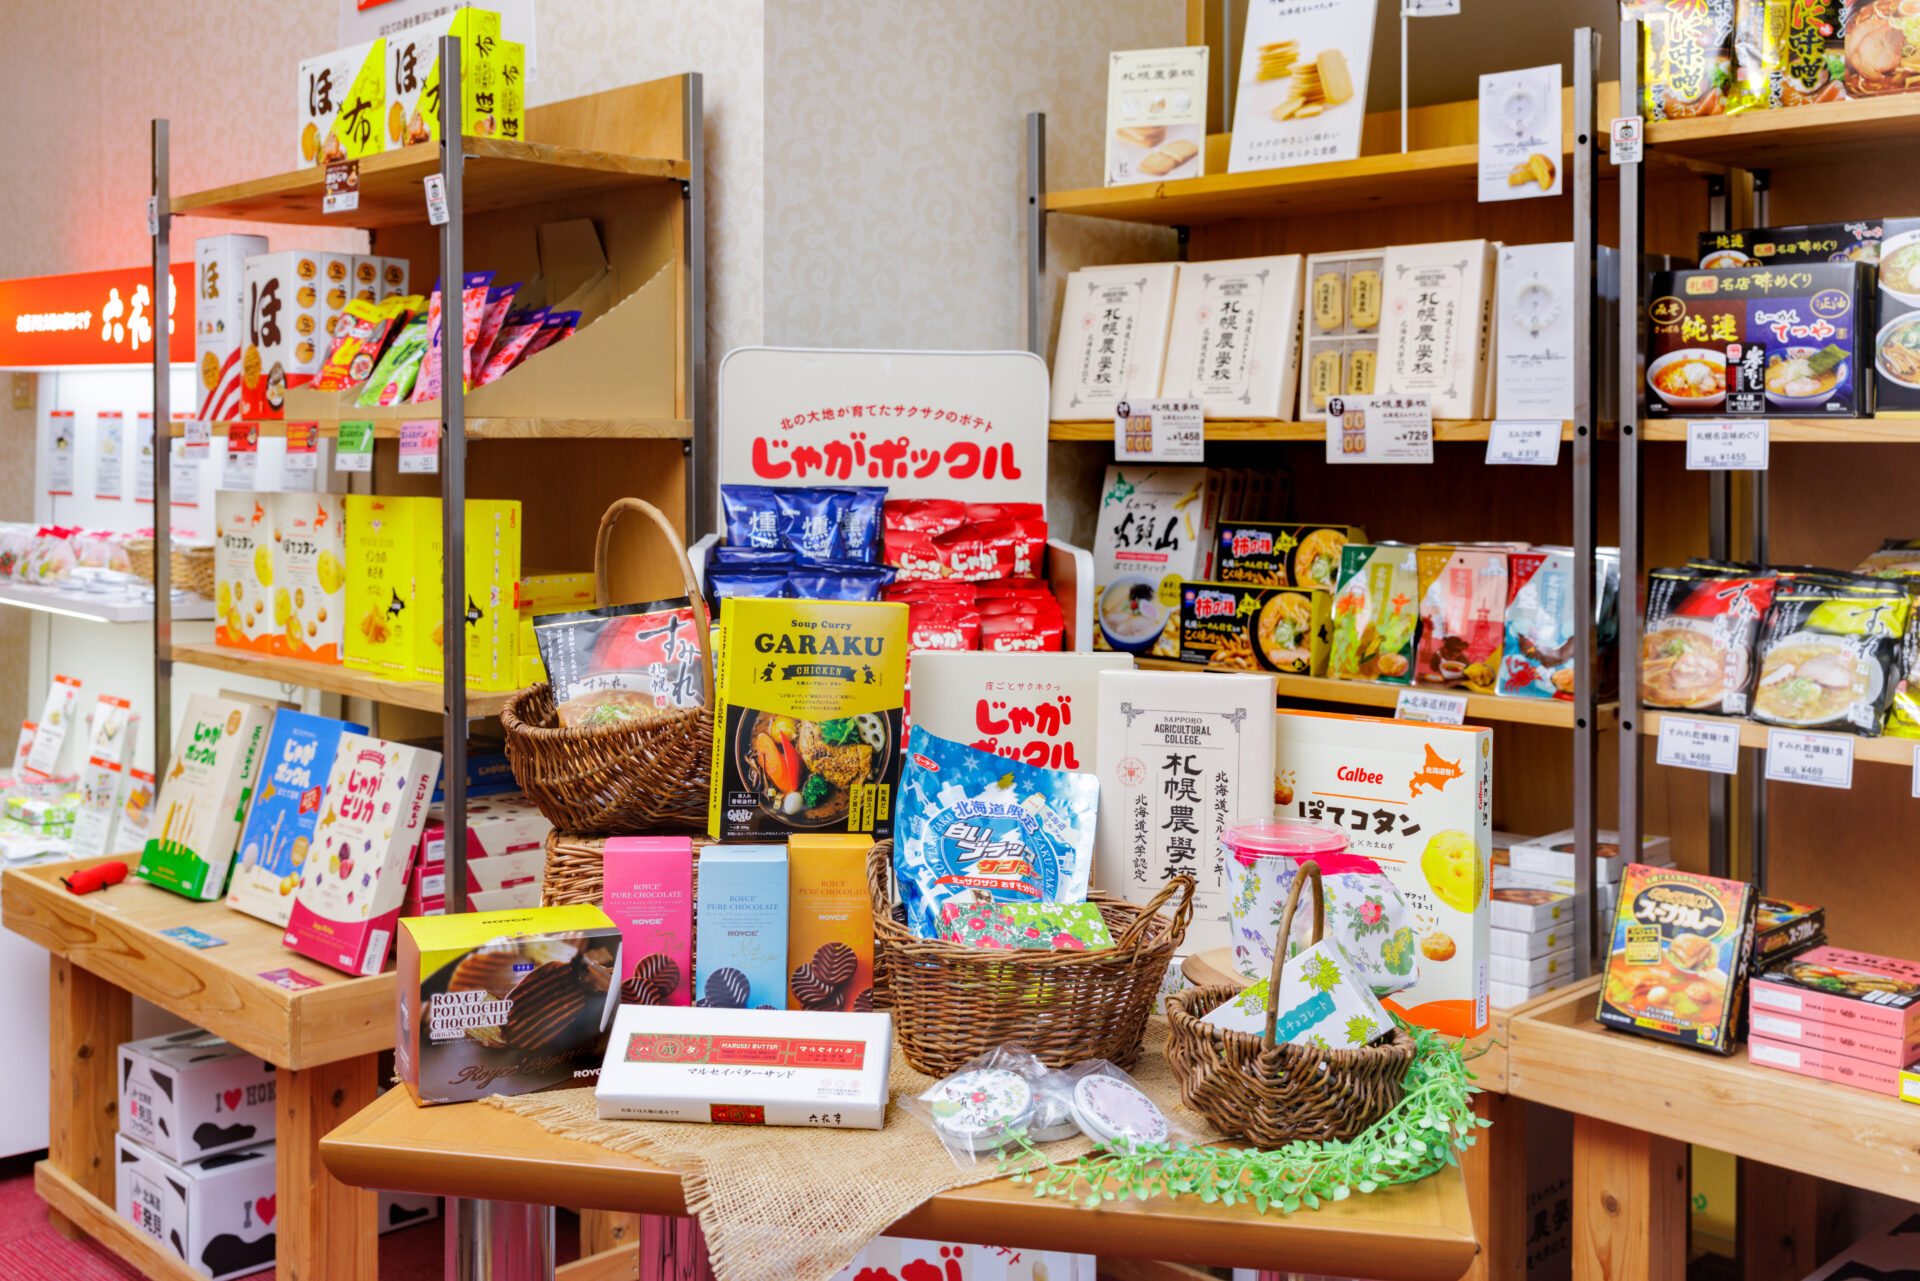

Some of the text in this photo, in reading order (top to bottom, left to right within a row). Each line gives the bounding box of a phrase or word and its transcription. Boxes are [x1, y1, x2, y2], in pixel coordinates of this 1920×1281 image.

[395, 42, 417, 95] ほ
[1789, 28, 1825, 88] 味噌
[309, 68, 333, 117] ほ
[201, 262, 219, 299] ほ
[1688, 271, 1812, 294] 札幌 名店味めぐり
[251, 278, 281, 347] ほ
[1654, 303, 1680, 316] みそ
[1410, 291, 1440, 375] 札幌農學校
[1681, 313, 1739, 343] 純連
[1771, 319, 1836, 344] てつや
[1210, 300, 1241, 382] 札幌農學校
[780, 403, 995, 434] 北の大地が育てたサクサクのポテト
[1402, 431, 1428, 441] ¥729
[1696, 431, 1760, 441] 札幌名店味めぐり
[752, 432, 1022, 481] じゃがポックル
[1232, 537, 1272, 558] 柿の種
[951, 549, 999, 571] じゃが
[1195, 598, 1235, 619] 柿の種
[791, 619, 853, 631] Soup Curry
[754, 633, 885, 657] GARAKU
[912, 629, 963, 649] じゃが
[994, 635, 1045, 651] じゃが
[636, 614, 702, 706] すみれ
[649, 663, 669, 693] 札幌
[796, 666, 843, 676] CHICKEN
[976, 695, 1072, 737] じゃが
[1163, 716, 1203, 724] SAPPORO
[1154, 724, 1212, 736] AGRICULTURAL
[283, 738, 319, 767] じゃが
[1690, 751, 1711, 762] ¥469
[1337, 766, 1384, 785] Calbee
[1801, 765, 1823, 777] ¥469
[348, 769, 385, 797] じゃが
[339, 794, 375, 824] ピリカ
[955, 800, 1039, 835] 北海道限定
[1160, 752, 1203, 884] 札幌農學校
[1298, 799, 1422, 838] ぽてコタン
[943, 823, 994, 843] 白い
[1132, 793, 1150, 883] 北海道大学認定
[1213, 770, 1229, 888] 北海道ミルクッキー
[957, 839, 1038, 865] ブラック
[976, 859, 1043, 880] サンダー
[611, 890, 683, 899] PURE CHOCOLATE
[799, 887, 868, 895] PURE CHOCOLATE
[706, 903, 779, 911] PURE CHOCOLATE
[1635, 899, 1723, 930] スープカレー
[433, 991, 487, 1006] ROYCE'
[433, 1001, 513, 1018] POTATOCHIP
[431, 1013, 509, 1030] CHOCOLATE
[431, 1030, 463, 1039] ORIGINAL
[721, 1042, 779, 1051] MARUSEI BUTTER
[799, 1046, 853, 1055] マルセイバタ
[687, 1067, 796, 1081] マルセイバターサンド
[808, 1113, 842, 1125] 六花亭
